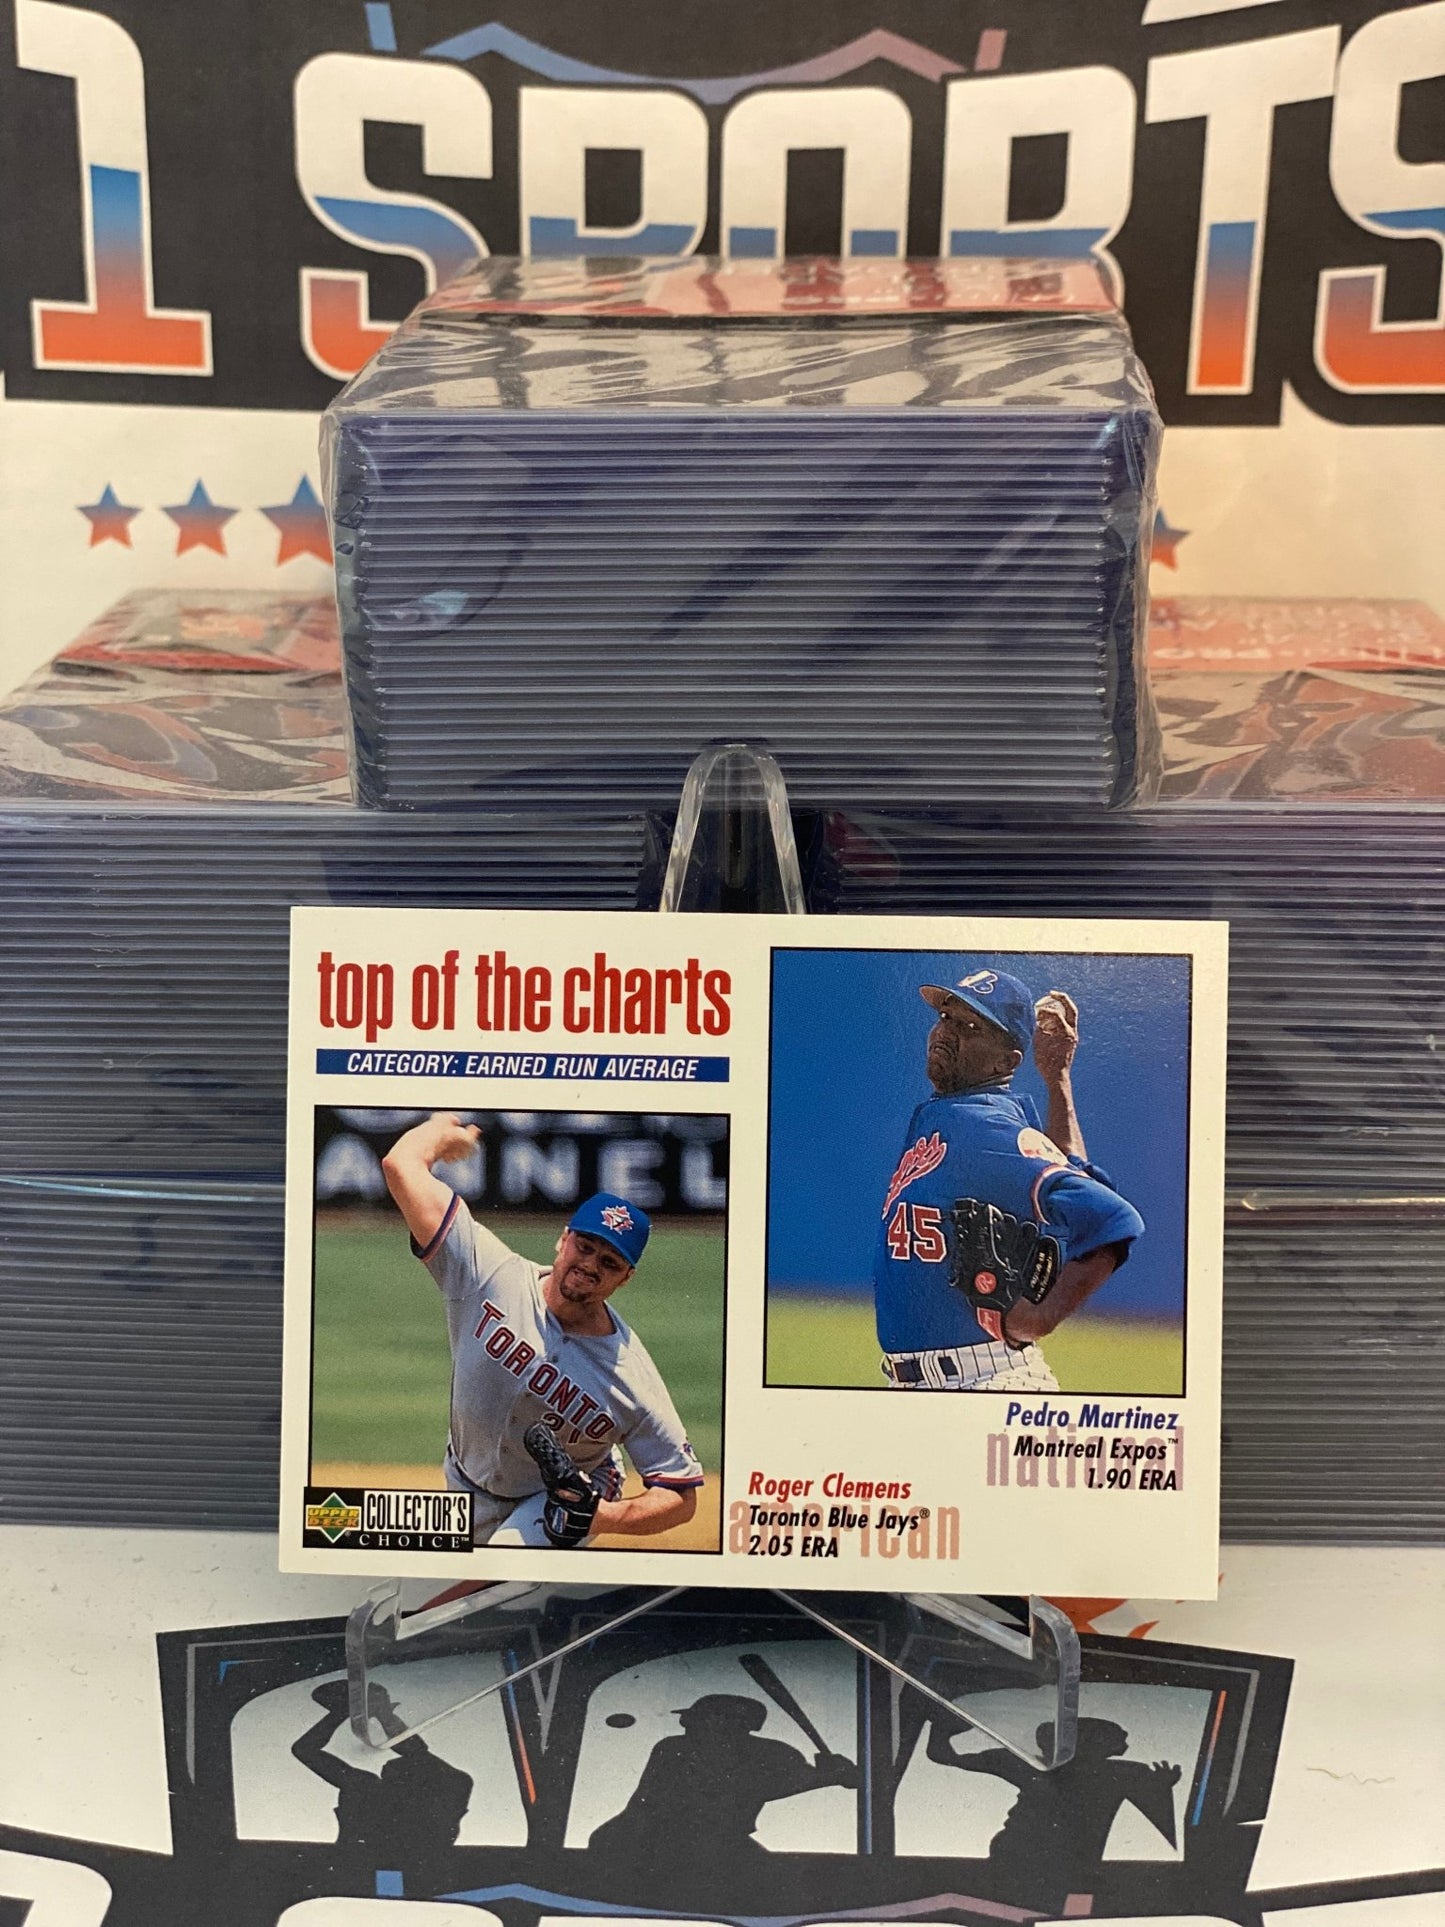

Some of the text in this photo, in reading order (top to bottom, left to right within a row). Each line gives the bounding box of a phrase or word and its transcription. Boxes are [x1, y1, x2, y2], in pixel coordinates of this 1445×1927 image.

[294, 2, 1445, 396] SPORTS
[317, 949, 732, 1043] top of the charts
[347, 1052, 700, 1080] CATEGORY: EARNED RUN AVERAGE
[888, 1202, 948, 1262] 45
[473, 1299, 617, 1441] TORONTO
[1006, 1401, 1179, 1430] Pedro Martinez
[1013, 1435, 1104, 1459] Montreal
[748, 1471, 912, 1503] Roger Clemens
[1087, 1468, 1177, 1491] 1.90 ERA
[308, 1507, 359, 1517] UPPER
[366, 1493, 468, 1533] COLLECTOR'S
[749, 1504, 820, 1528] Toronto
[827, 1506, 869, 1529] Blue
[748, 1534, 839, 1558] 2.05 ERA
